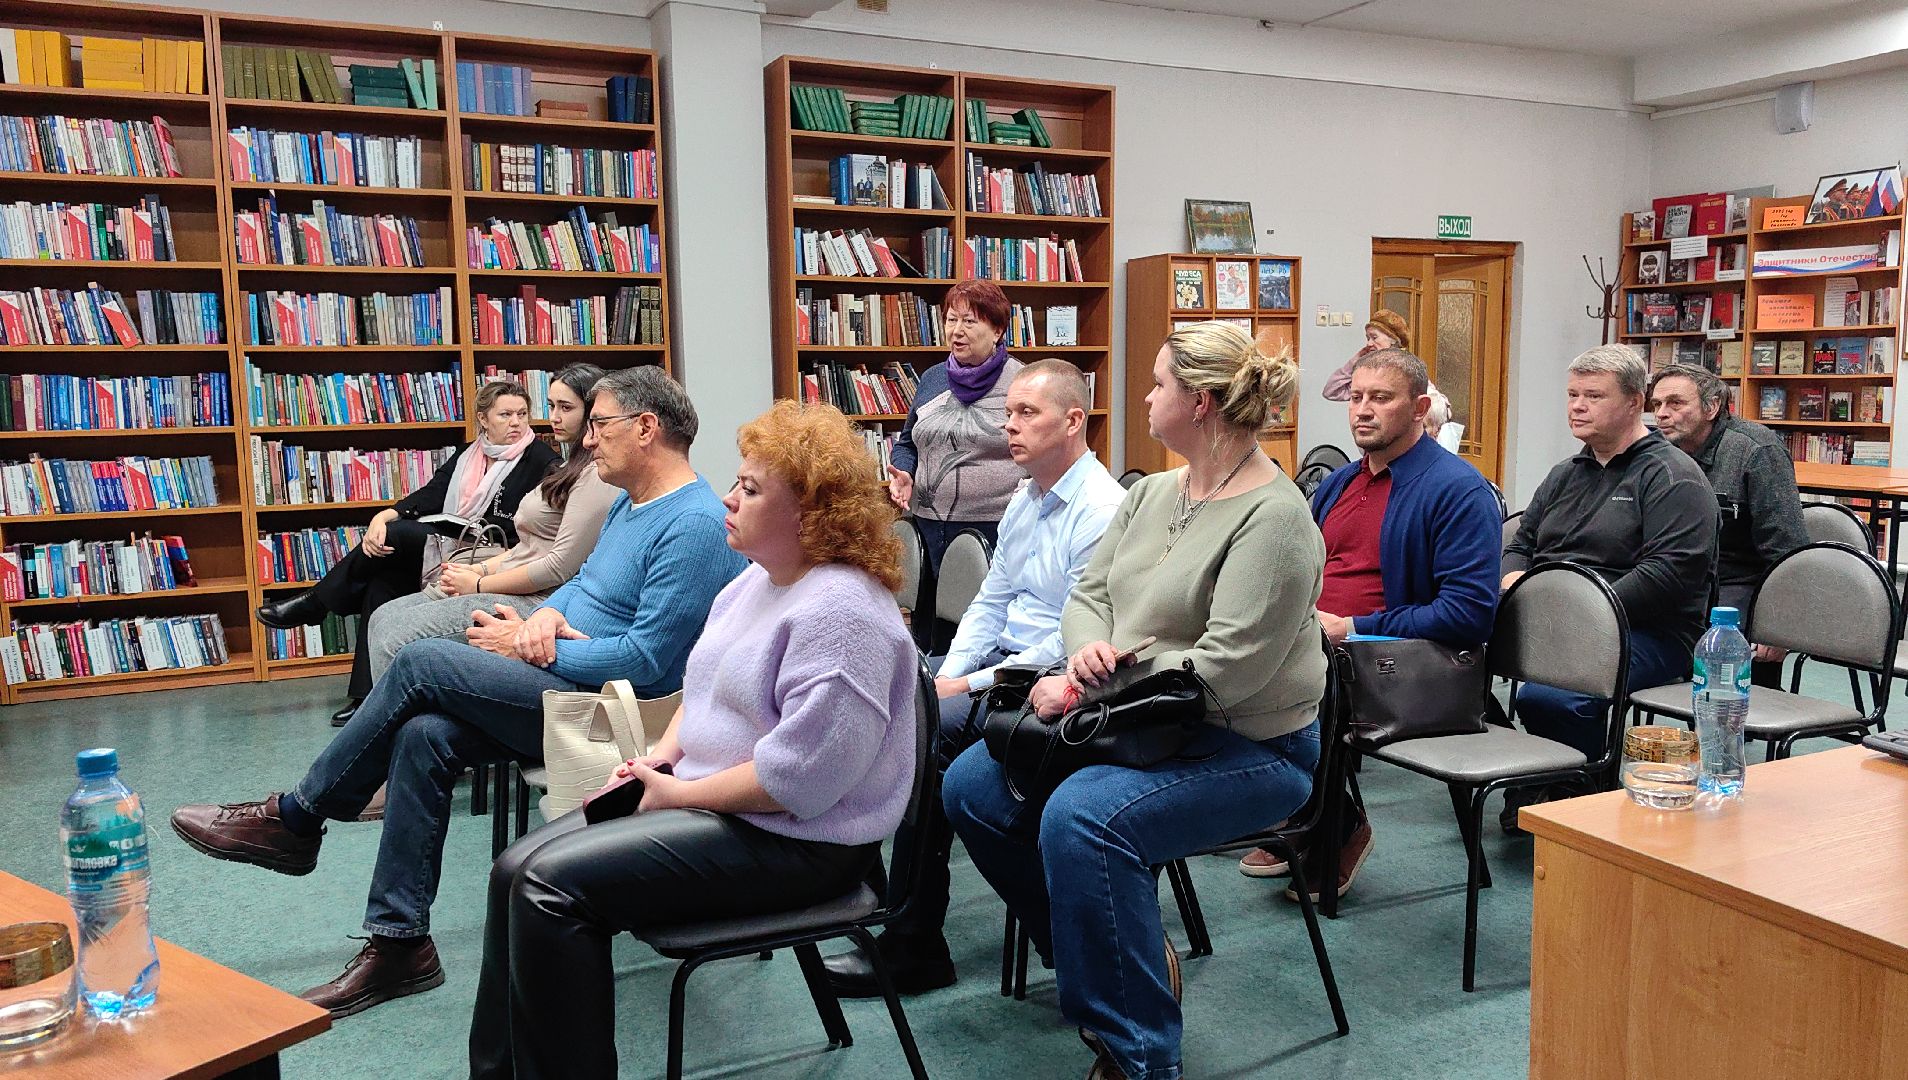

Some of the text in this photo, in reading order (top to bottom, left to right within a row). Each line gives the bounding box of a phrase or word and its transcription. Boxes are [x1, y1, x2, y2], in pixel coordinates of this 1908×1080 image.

[1439, 218, 1471, 235] ВЫХОД
[1757, 253, 1878, 267] Защитники Отечества
[1175, 270, 1202, 278] ЧУДЕСА
